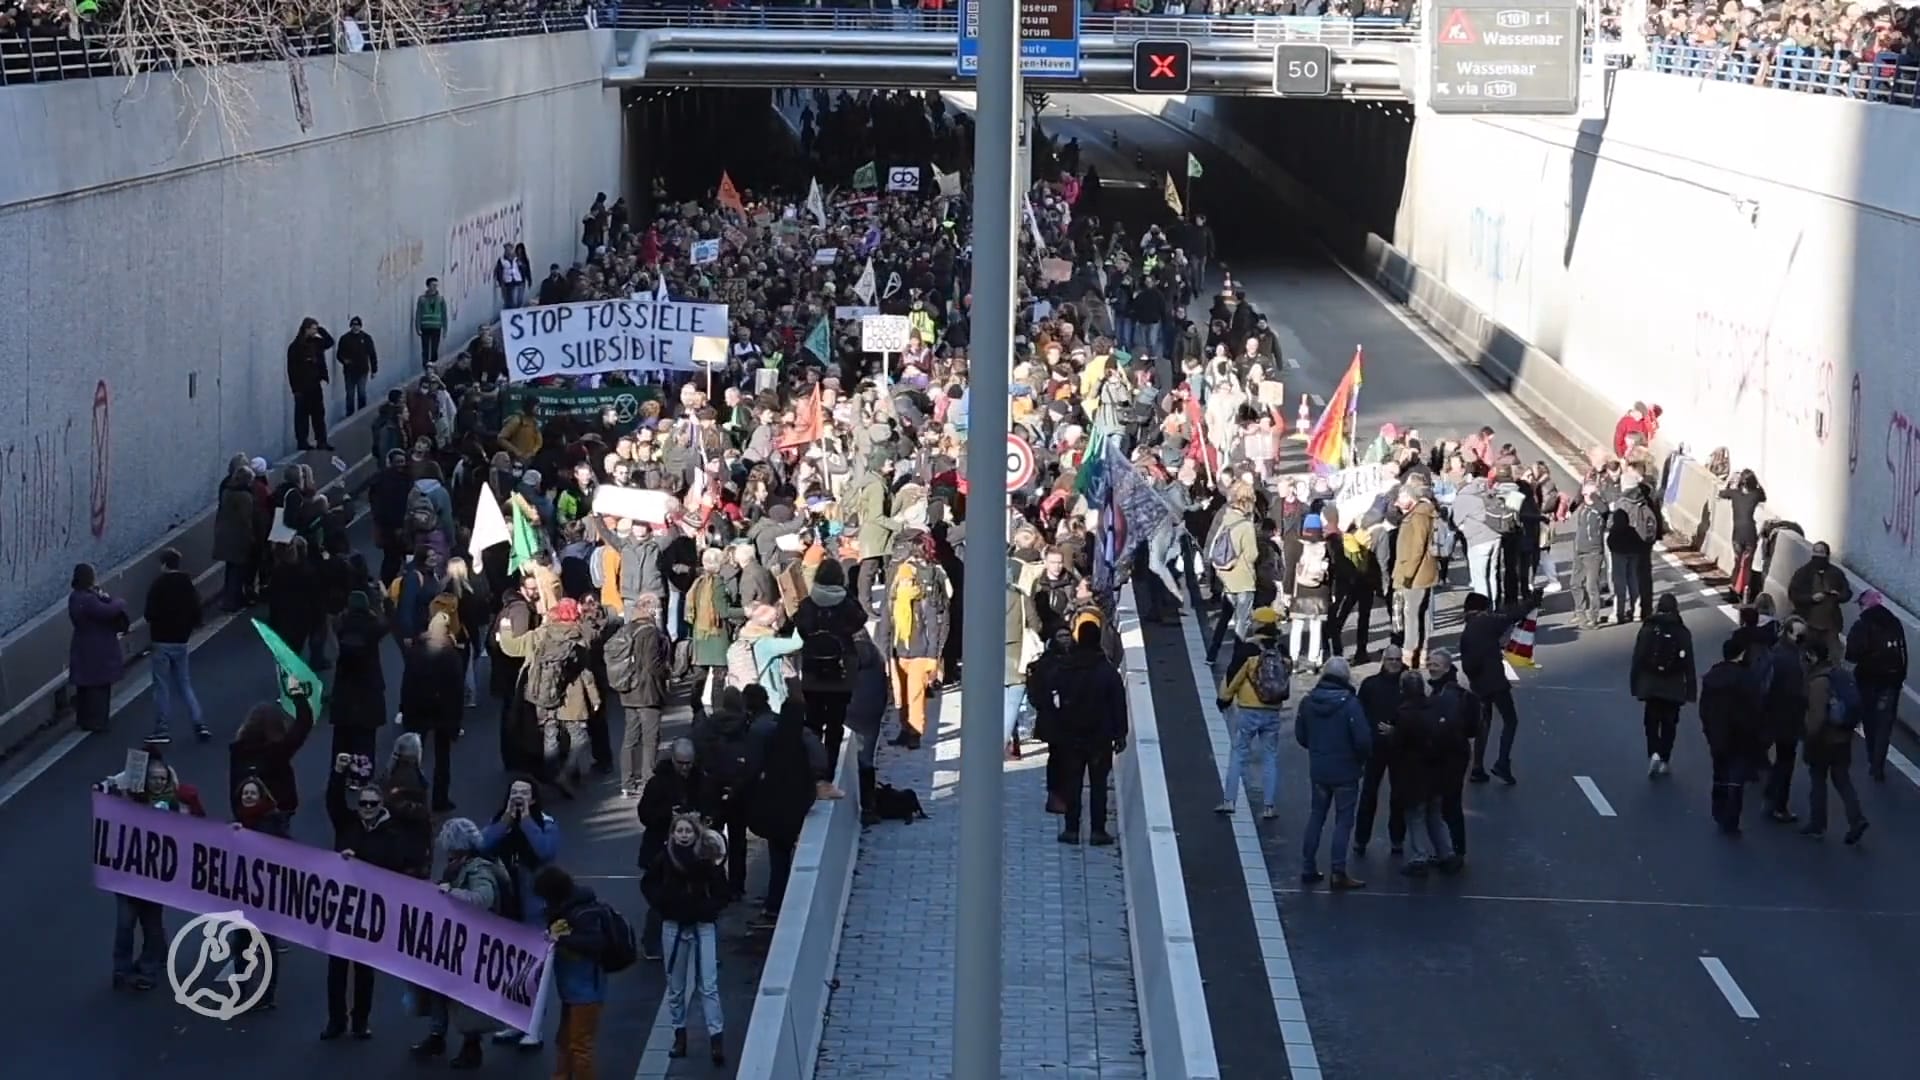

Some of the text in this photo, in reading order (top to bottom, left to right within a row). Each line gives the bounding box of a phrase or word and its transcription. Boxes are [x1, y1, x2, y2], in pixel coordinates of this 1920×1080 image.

[1021, 4, 1057, 12] useum
[1021, 16, 1049, 24] rsum
[1535, 11, 1549, 25] ri
[1021, 28, 1050, 36] orum
[1483, 32, 1563, 45] Wassenaar
[1022, 45, 1047, 53] oute
[1288, 61, 1318, 78] 50
[1456, 62, 1536, 75] Wassenaar
[1457, 81, 1479, 95] via
[510, 302, 706, 340] STOP FOSSIELE
[561, 329, 675, 369] SUBSIDIE
[191, 842, 386, 943] BELASTINGGELD
[397, 903, 468, 977] NAAR
